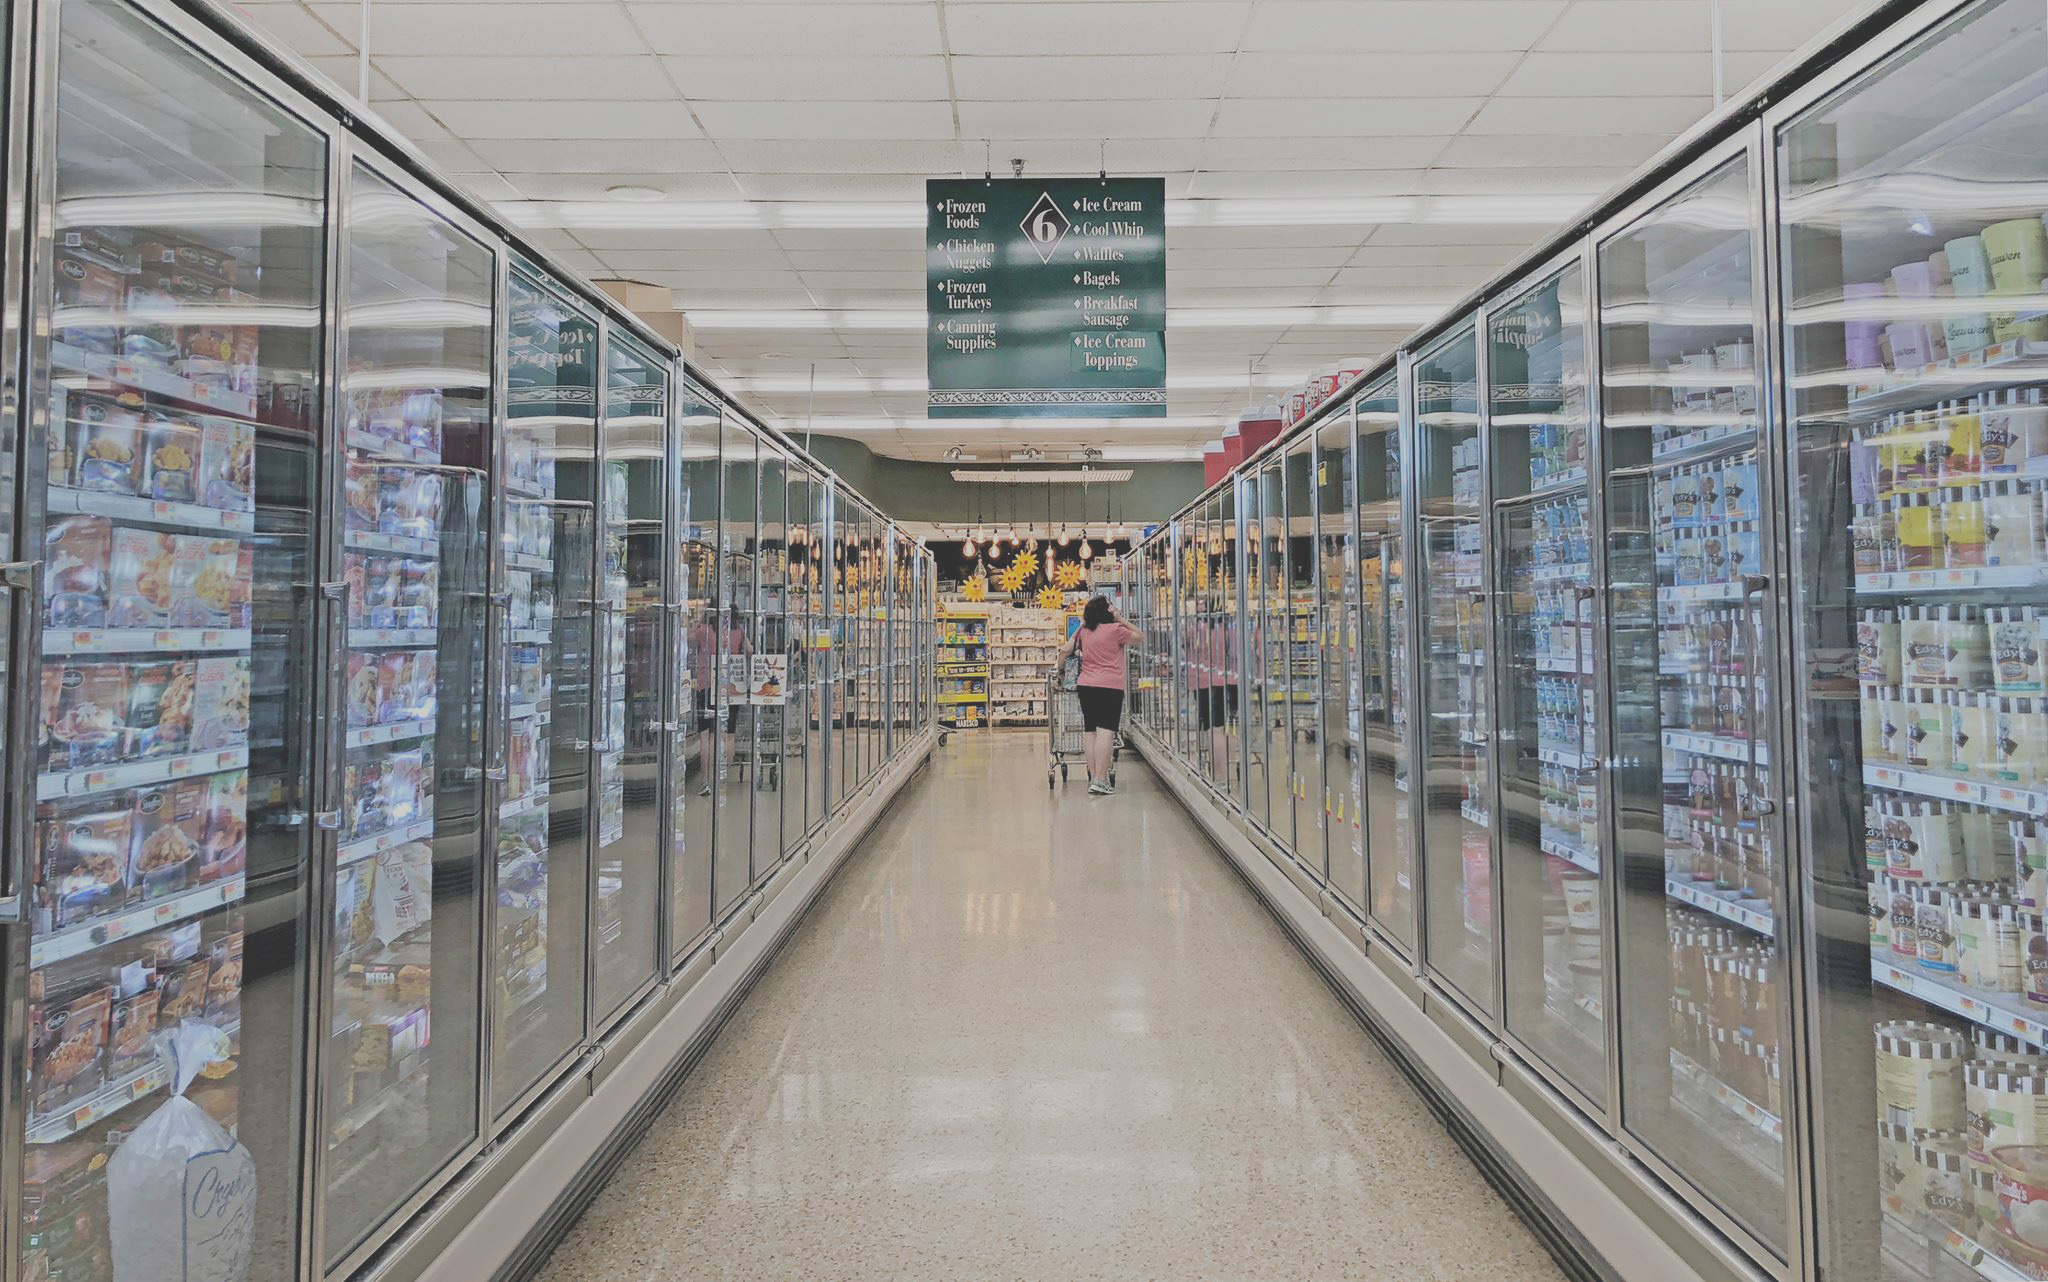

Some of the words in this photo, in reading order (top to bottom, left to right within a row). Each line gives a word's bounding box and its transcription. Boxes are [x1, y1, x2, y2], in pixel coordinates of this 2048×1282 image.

[946, 199, 986, 214] Frozen
[1083, 198, 1099, 212] Ice
[1103, 197, 1142, 212] Cream
[946, 215, 979, 229] Foods
[1033, 209, 1057, 242] 6
[1083, 222, 1109, 236] Cool
[1112, 222, 1143, 239] Whip
[946, 239, 994, 253] Chicken
[1083, 246, 1124, 261] Waffles
[946, 255, 991, 273] Nuggets
[946, 279, 986, 293] Frozen
[1083, 271, 1120, 289] Bagels
[946, 296, 991, 313] Turkeys
[1083, 296, 1138, 309] Breakfast
[1083, 312, 1129, 329] Sausage
[947, 319, 996, 338] Canning
[947, 336, 996, 353] Supplies
[1083, 334, 1101, 348] Ice
[1105, 335, 1146, 348] Cream
[1084, 352, 1137, 370] Toppings
[1982, 431, 2006, 443] dy's
[1918, 927, 1944, 942] Edy's
